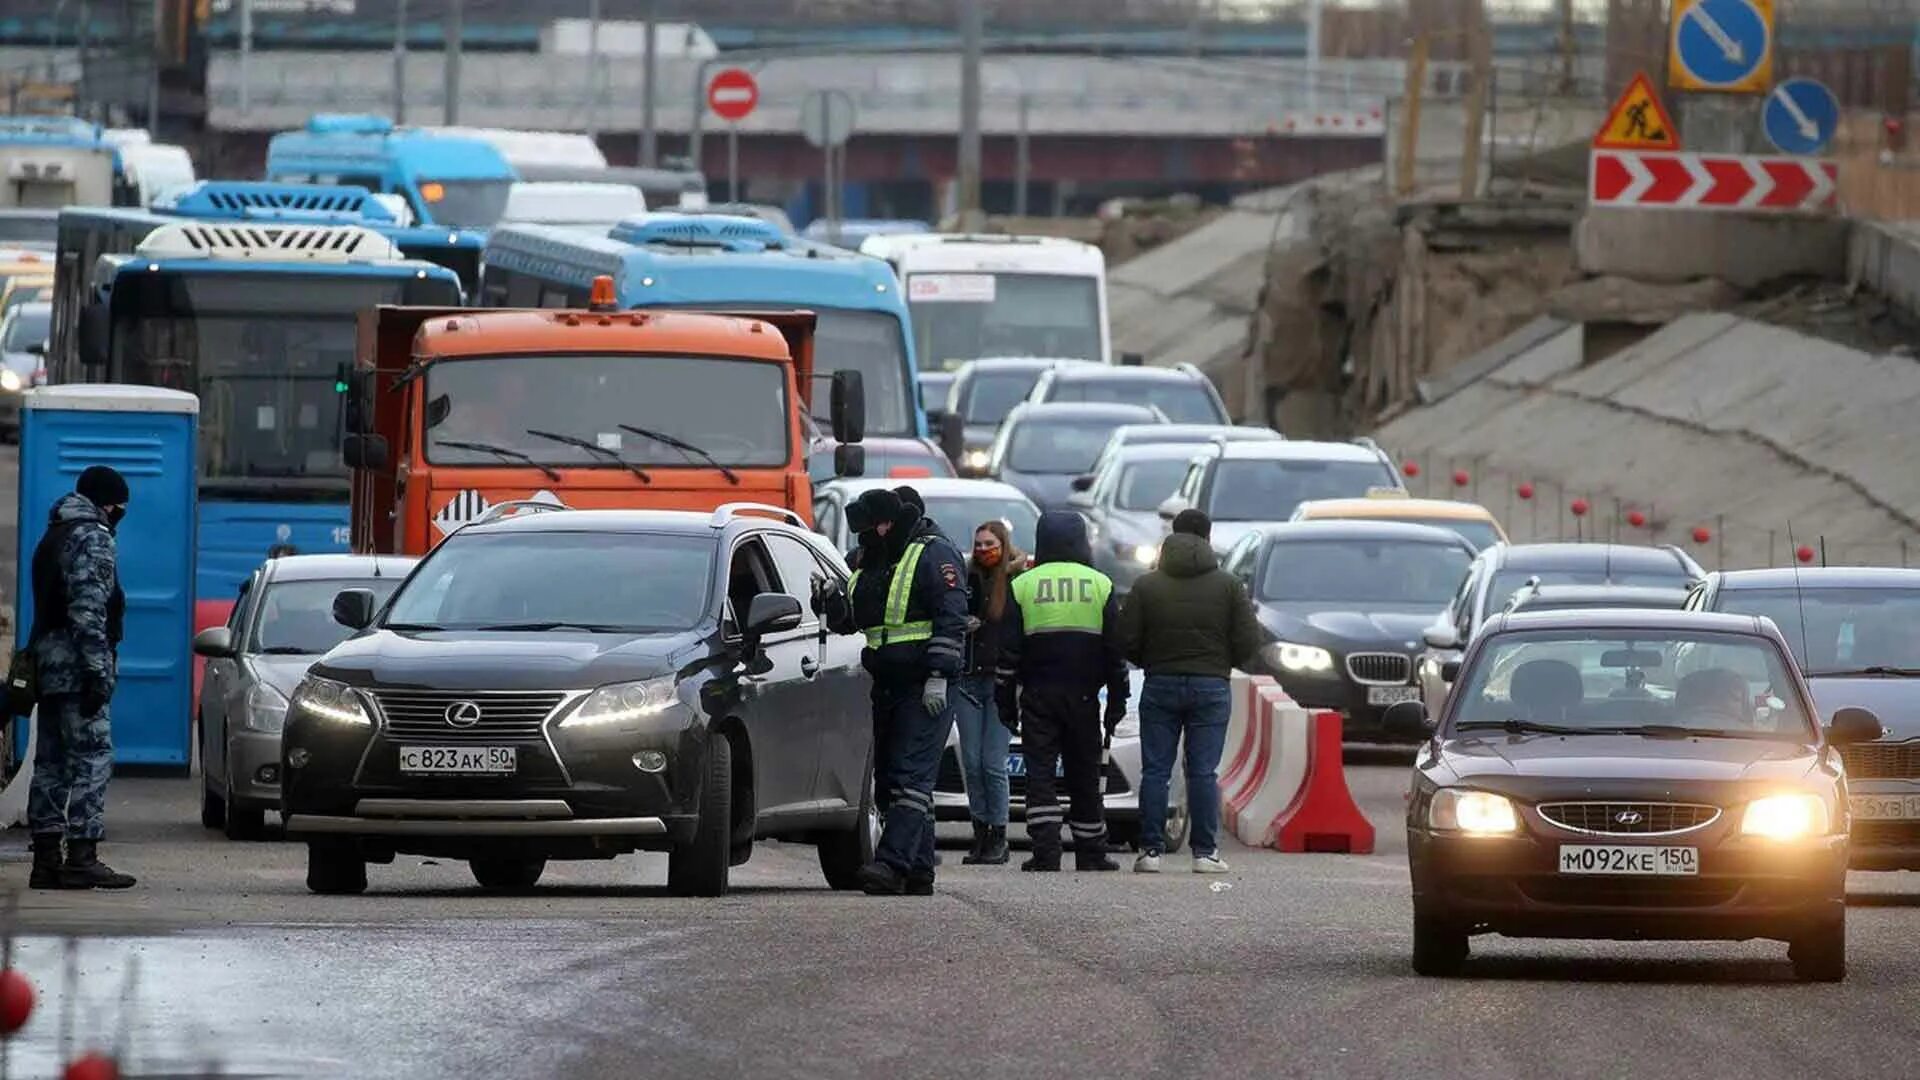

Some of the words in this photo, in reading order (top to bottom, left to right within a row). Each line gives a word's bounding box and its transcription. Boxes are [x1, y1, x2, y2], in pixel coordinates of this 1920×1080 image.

[1033, 577, 1093, 604] ДПС
[490, 749, 510, 763] 50
[1565, 848, 1654, 871] М092КЕ
[1660, 848, 1692, 865] 150
